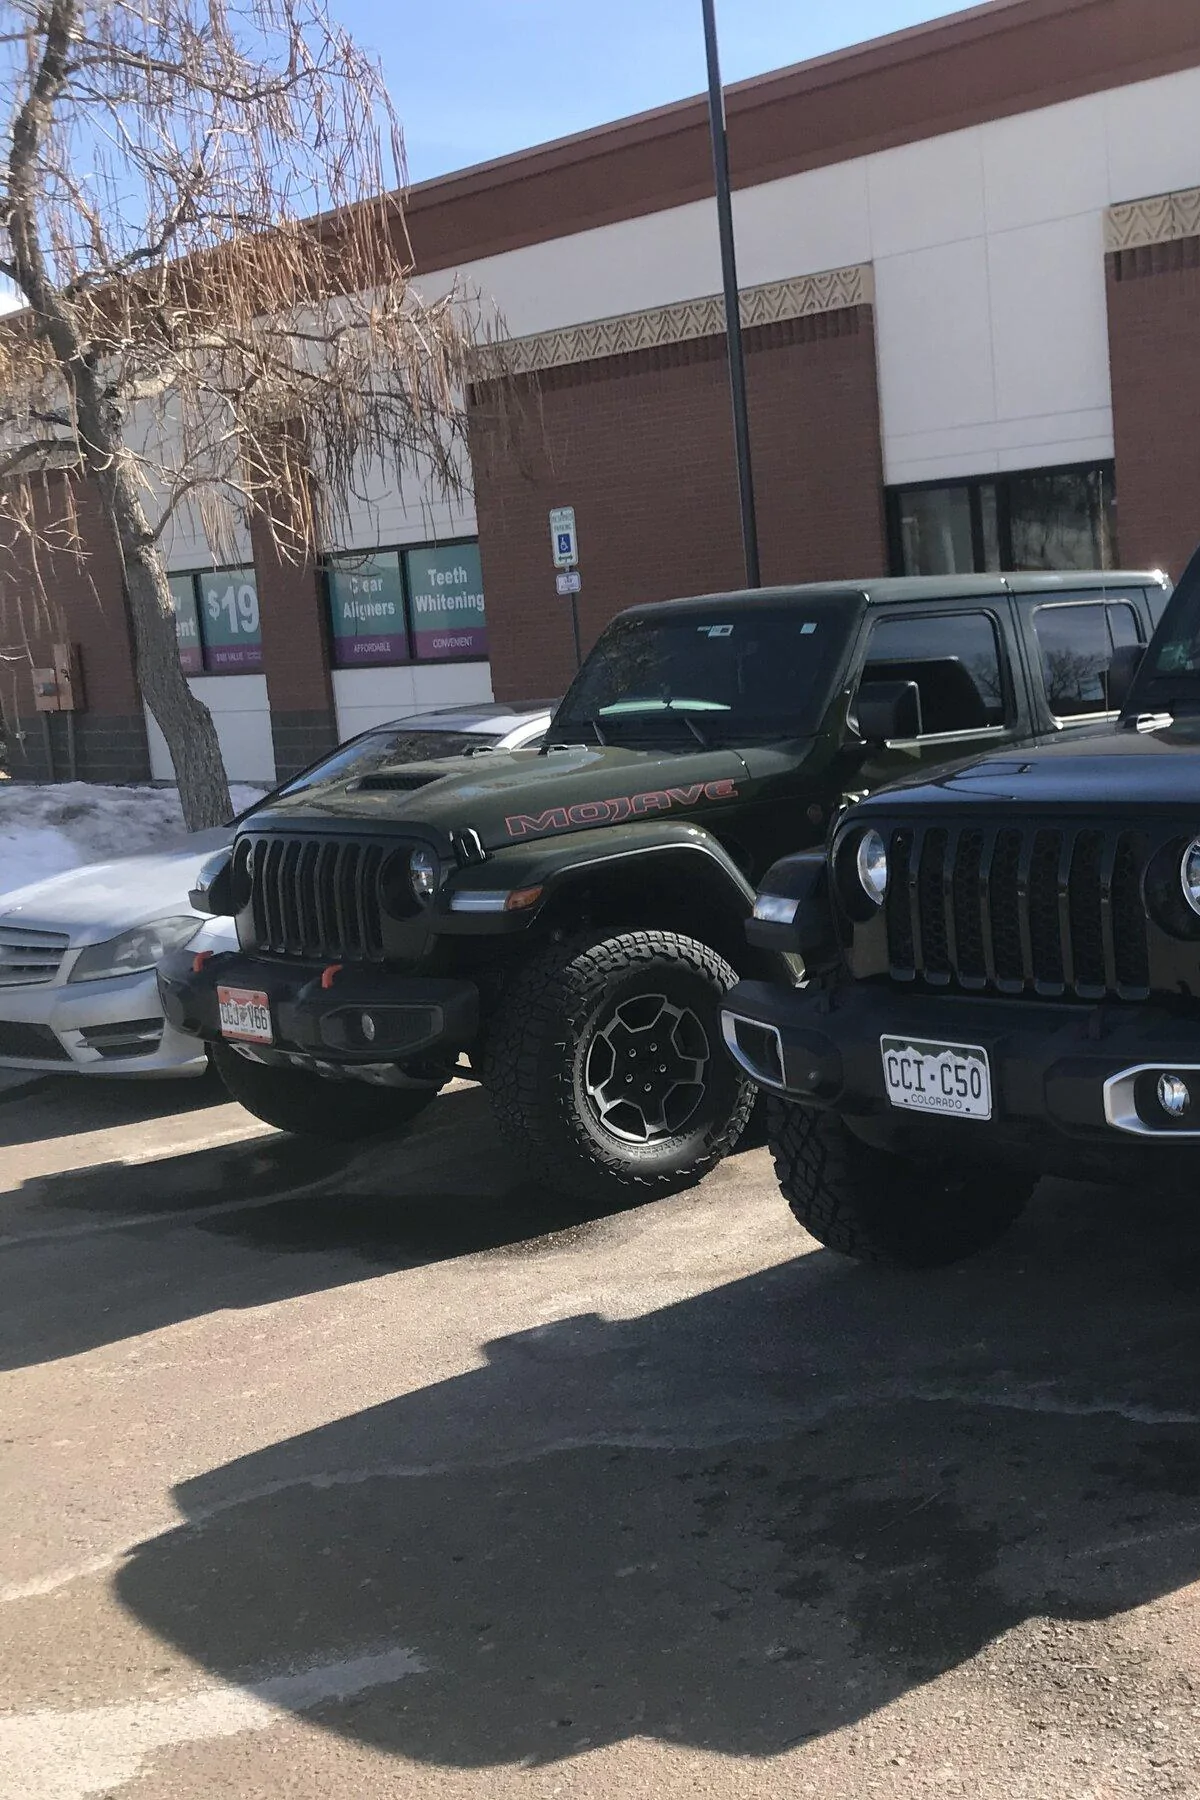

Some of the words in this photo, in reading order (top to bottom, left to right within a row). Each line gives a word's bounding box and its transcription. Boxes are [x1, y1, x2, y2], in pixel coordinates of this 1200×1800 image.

[427, 566, 468, 587] Teeth
[207, 584, 260, 634] $19
[343, 600, 396, 621] Aligners
[415, 591, 485, 613] Whitening
[353, 641, 391, 653] AFFORDABLE
[432, 636, 473, 649] CONVENIENT
[505, 778, 739, 837] MOJAVE
[247, 1004, 268, 1030] V66
[911, 1093, 963, 1110] COLORADO
